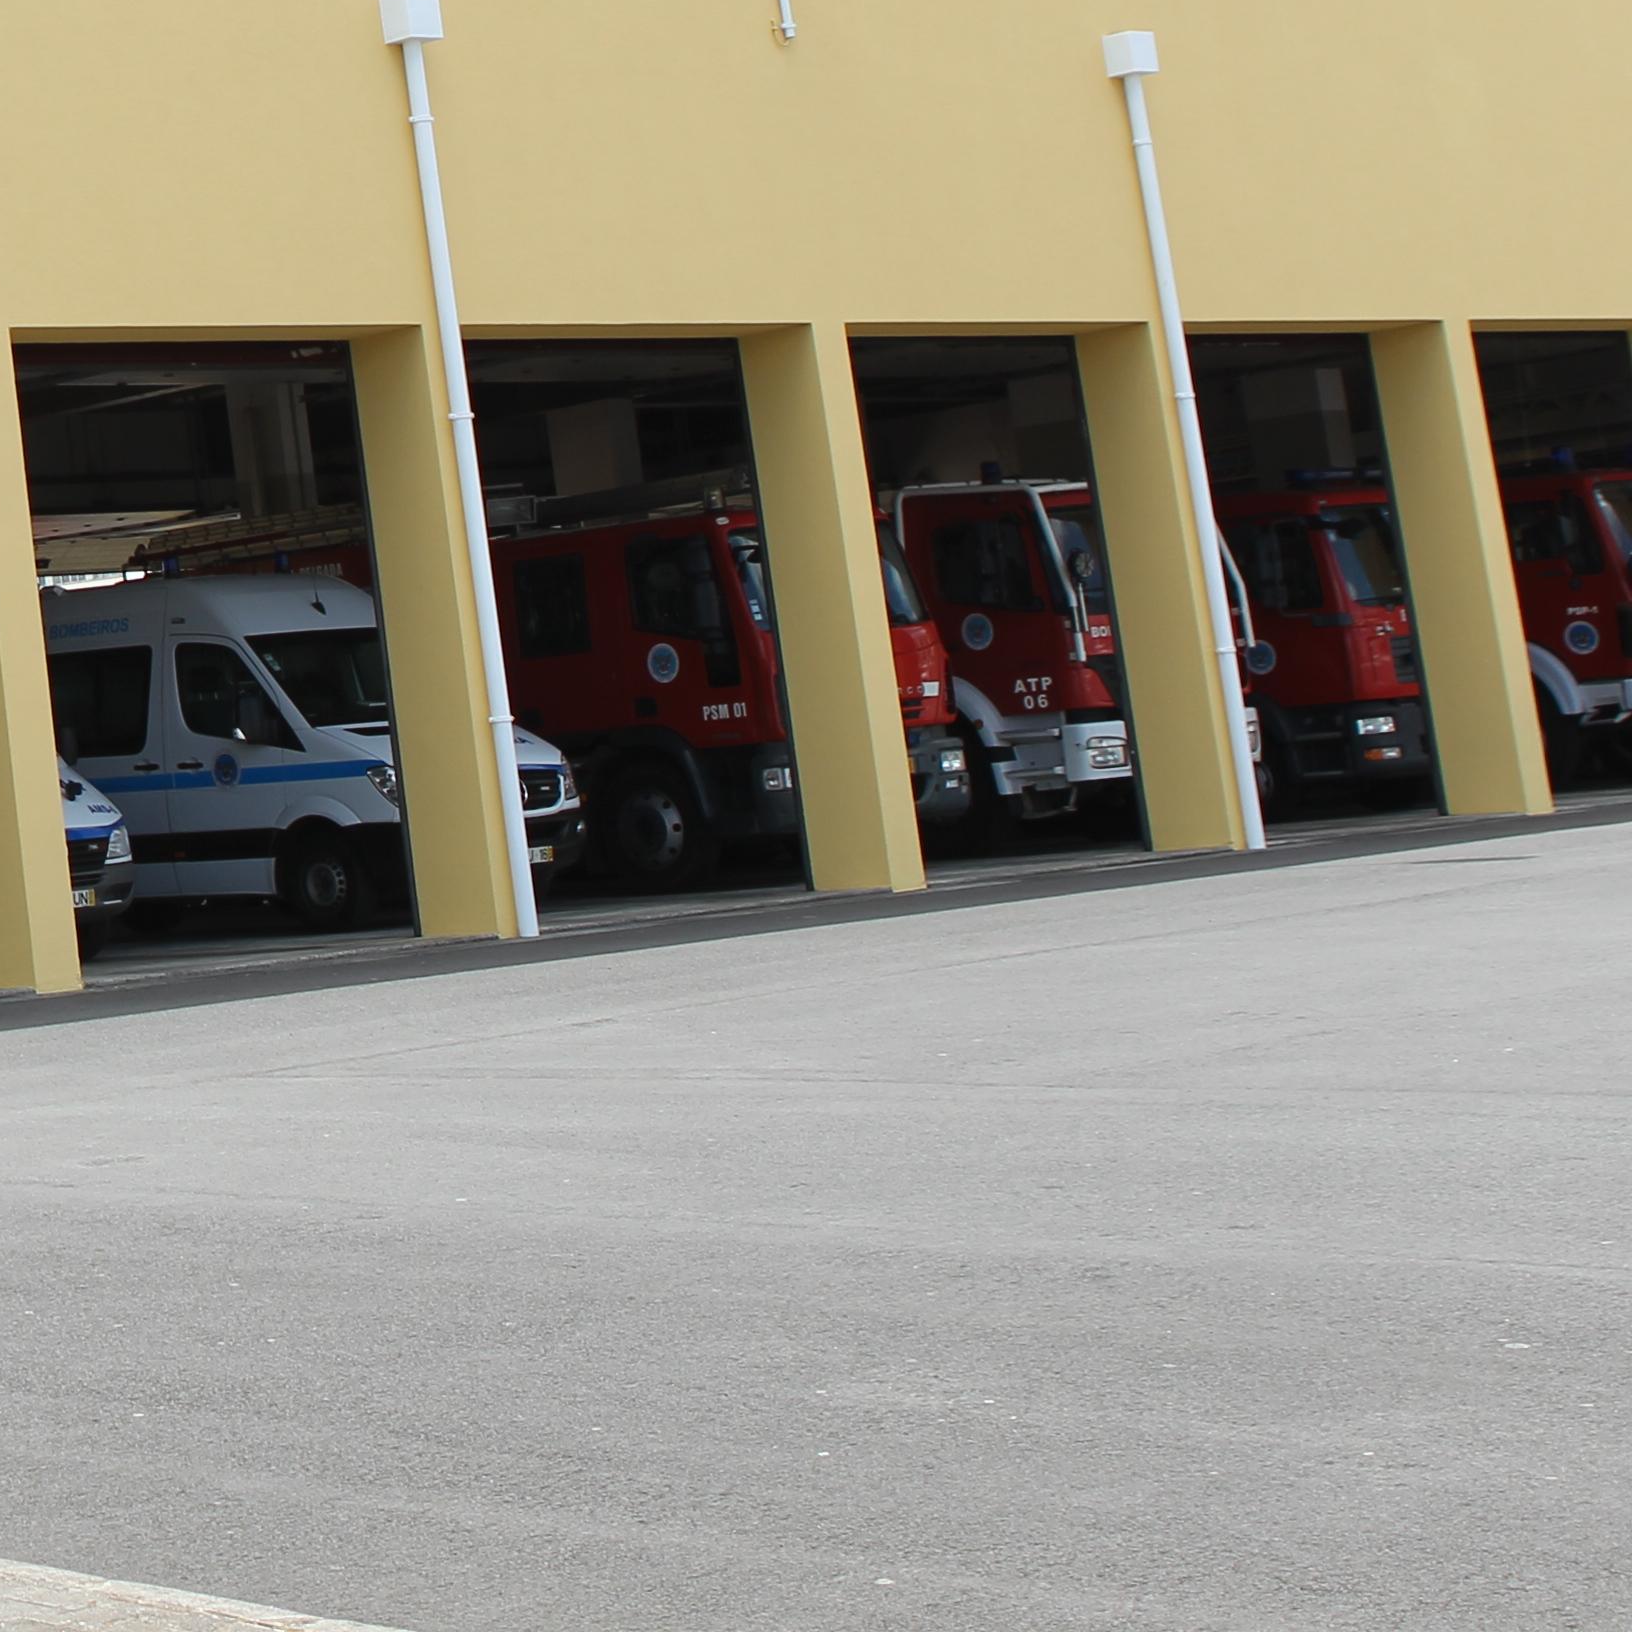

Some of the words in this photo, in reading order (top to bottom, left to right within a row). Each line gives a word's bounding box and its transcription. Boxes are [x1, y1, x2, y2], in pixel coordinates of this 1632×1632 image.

[49, 617, 129, 640] BOMBEIROS
[1014, 676, 1053, 694] ATP
[1023, 694, 1049, 709] 06
[702, 704, 730, 721] PSM
[733, 702, 748, 718] 01
